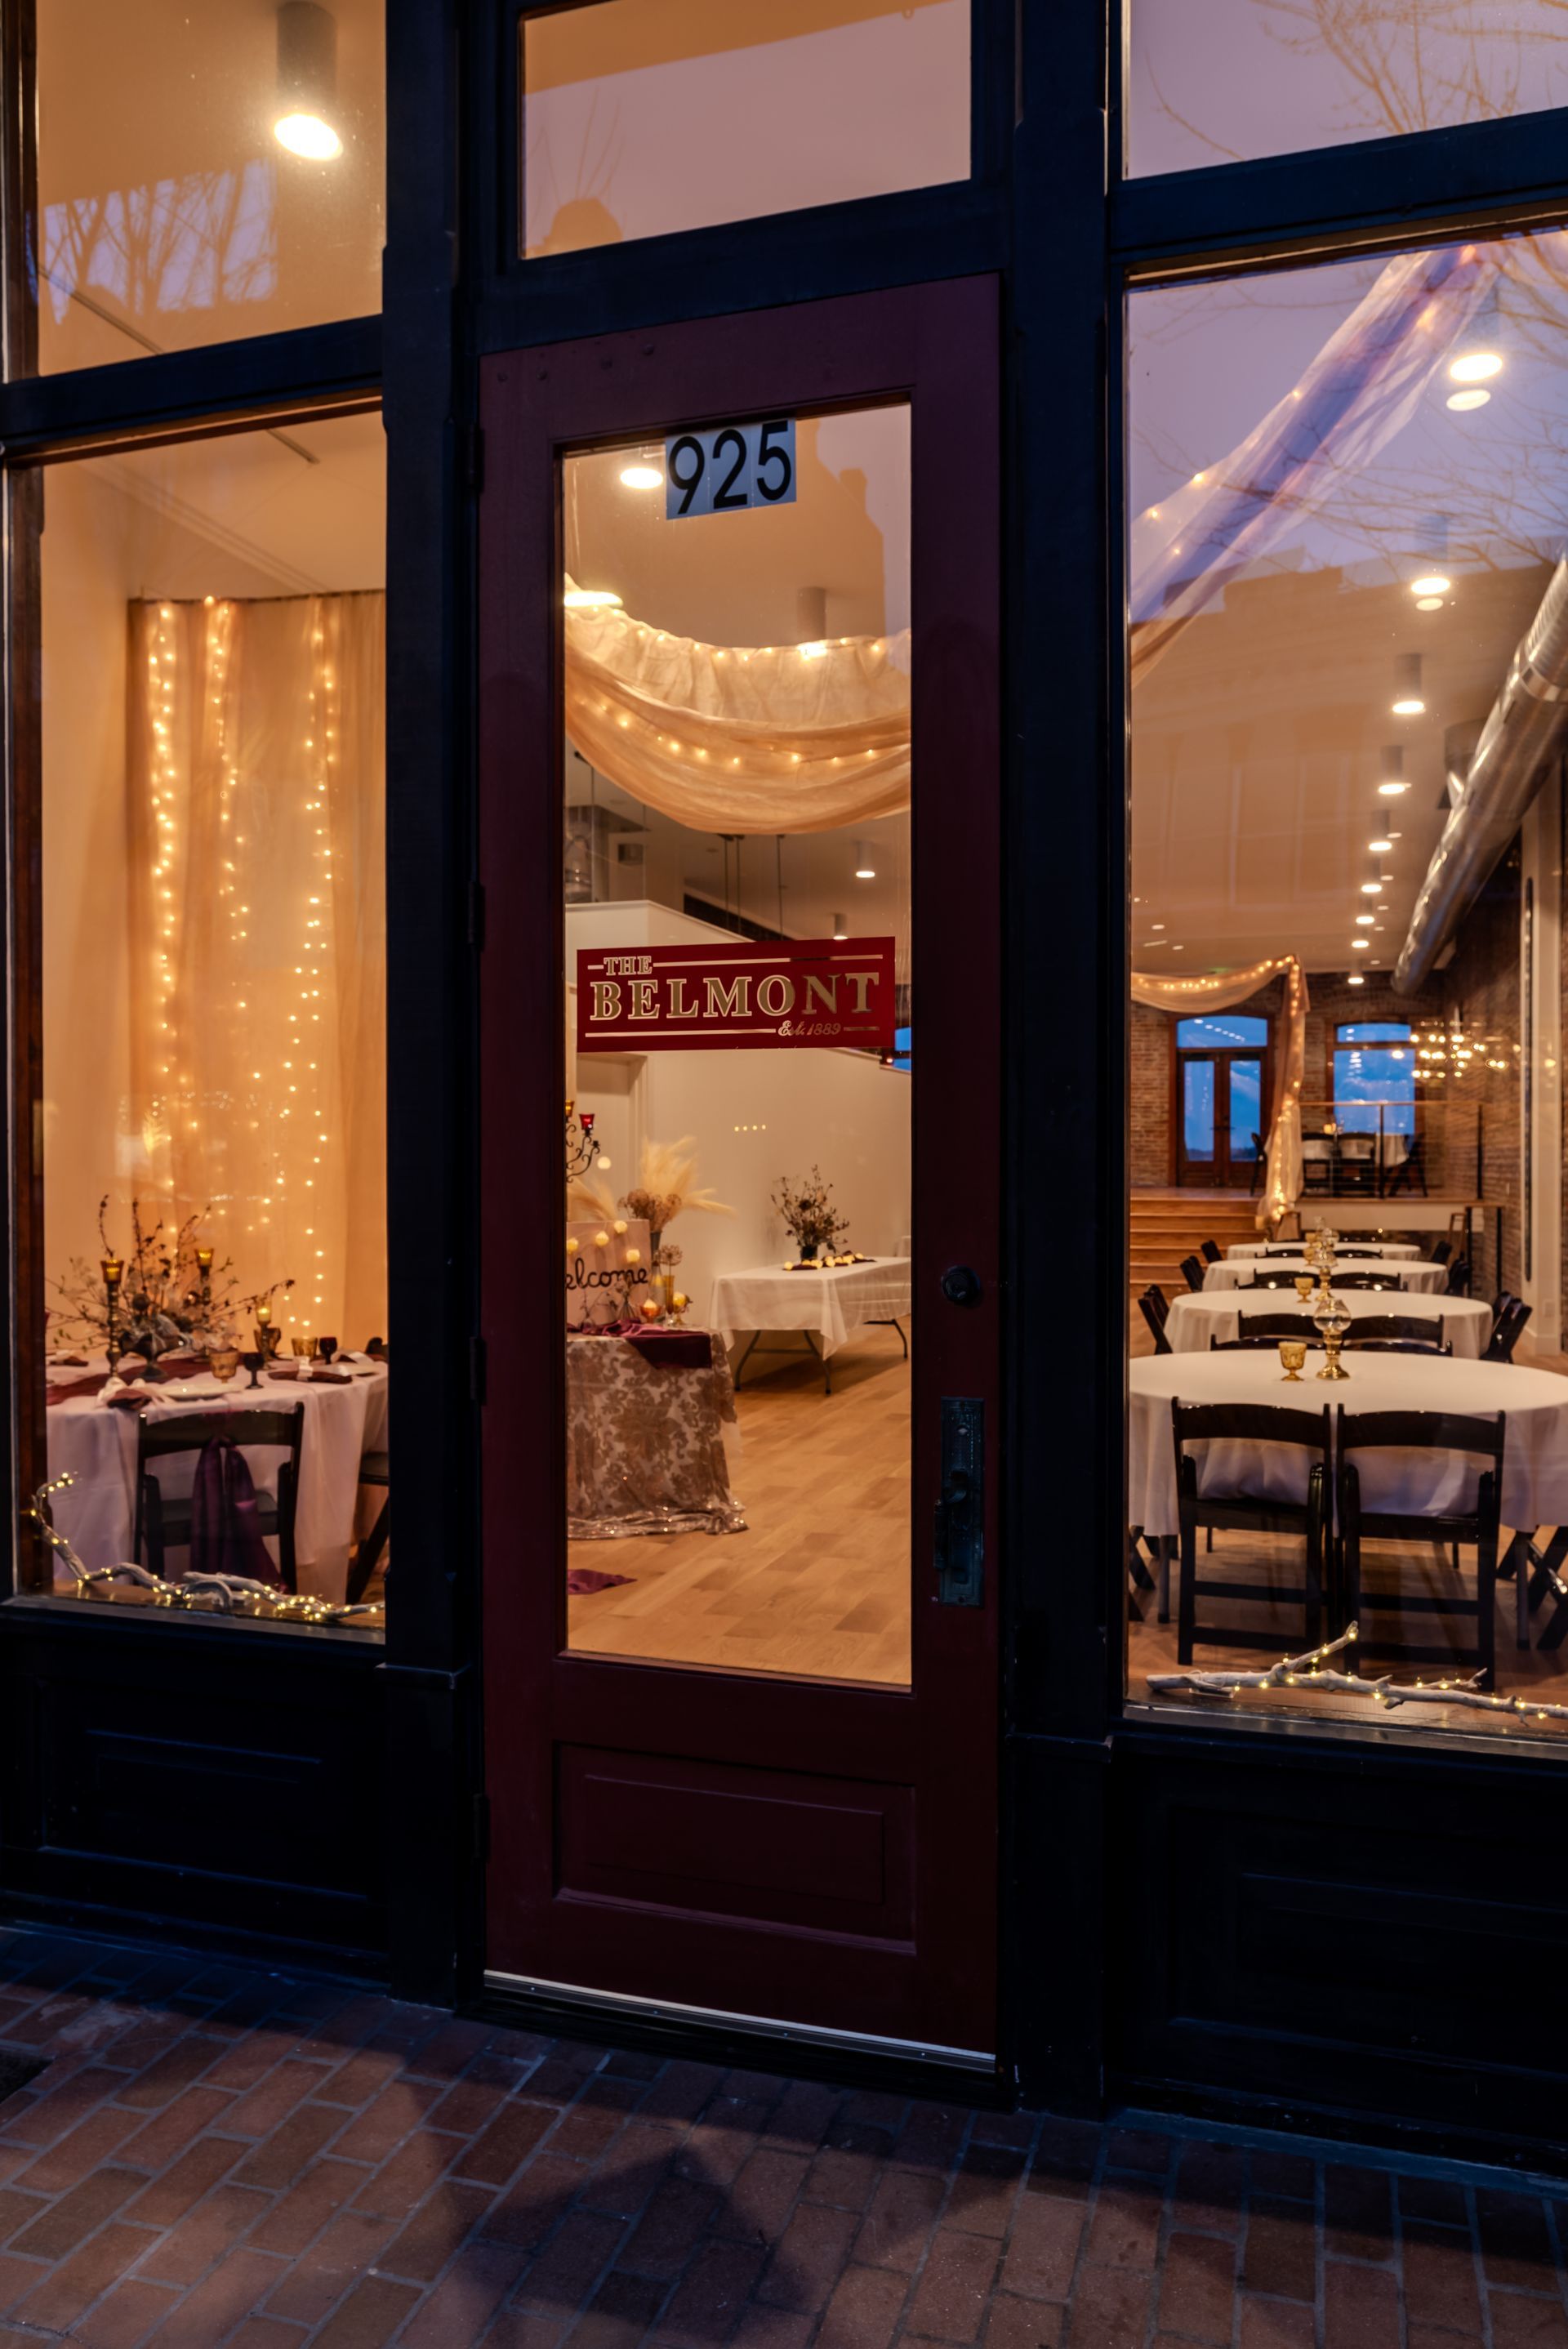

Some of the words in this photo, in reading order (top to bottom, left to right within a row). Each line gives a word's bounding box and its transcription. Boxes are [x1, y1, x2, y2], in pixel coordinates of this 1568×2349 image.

[668, 420, 792, 515] 925
[603, 955, 653, 976] THE
[589, 971, 880, 1021] BELMONT
[806, 1022, 841, 1036] 1889
[566, 1257, 649, 1290] elcome
